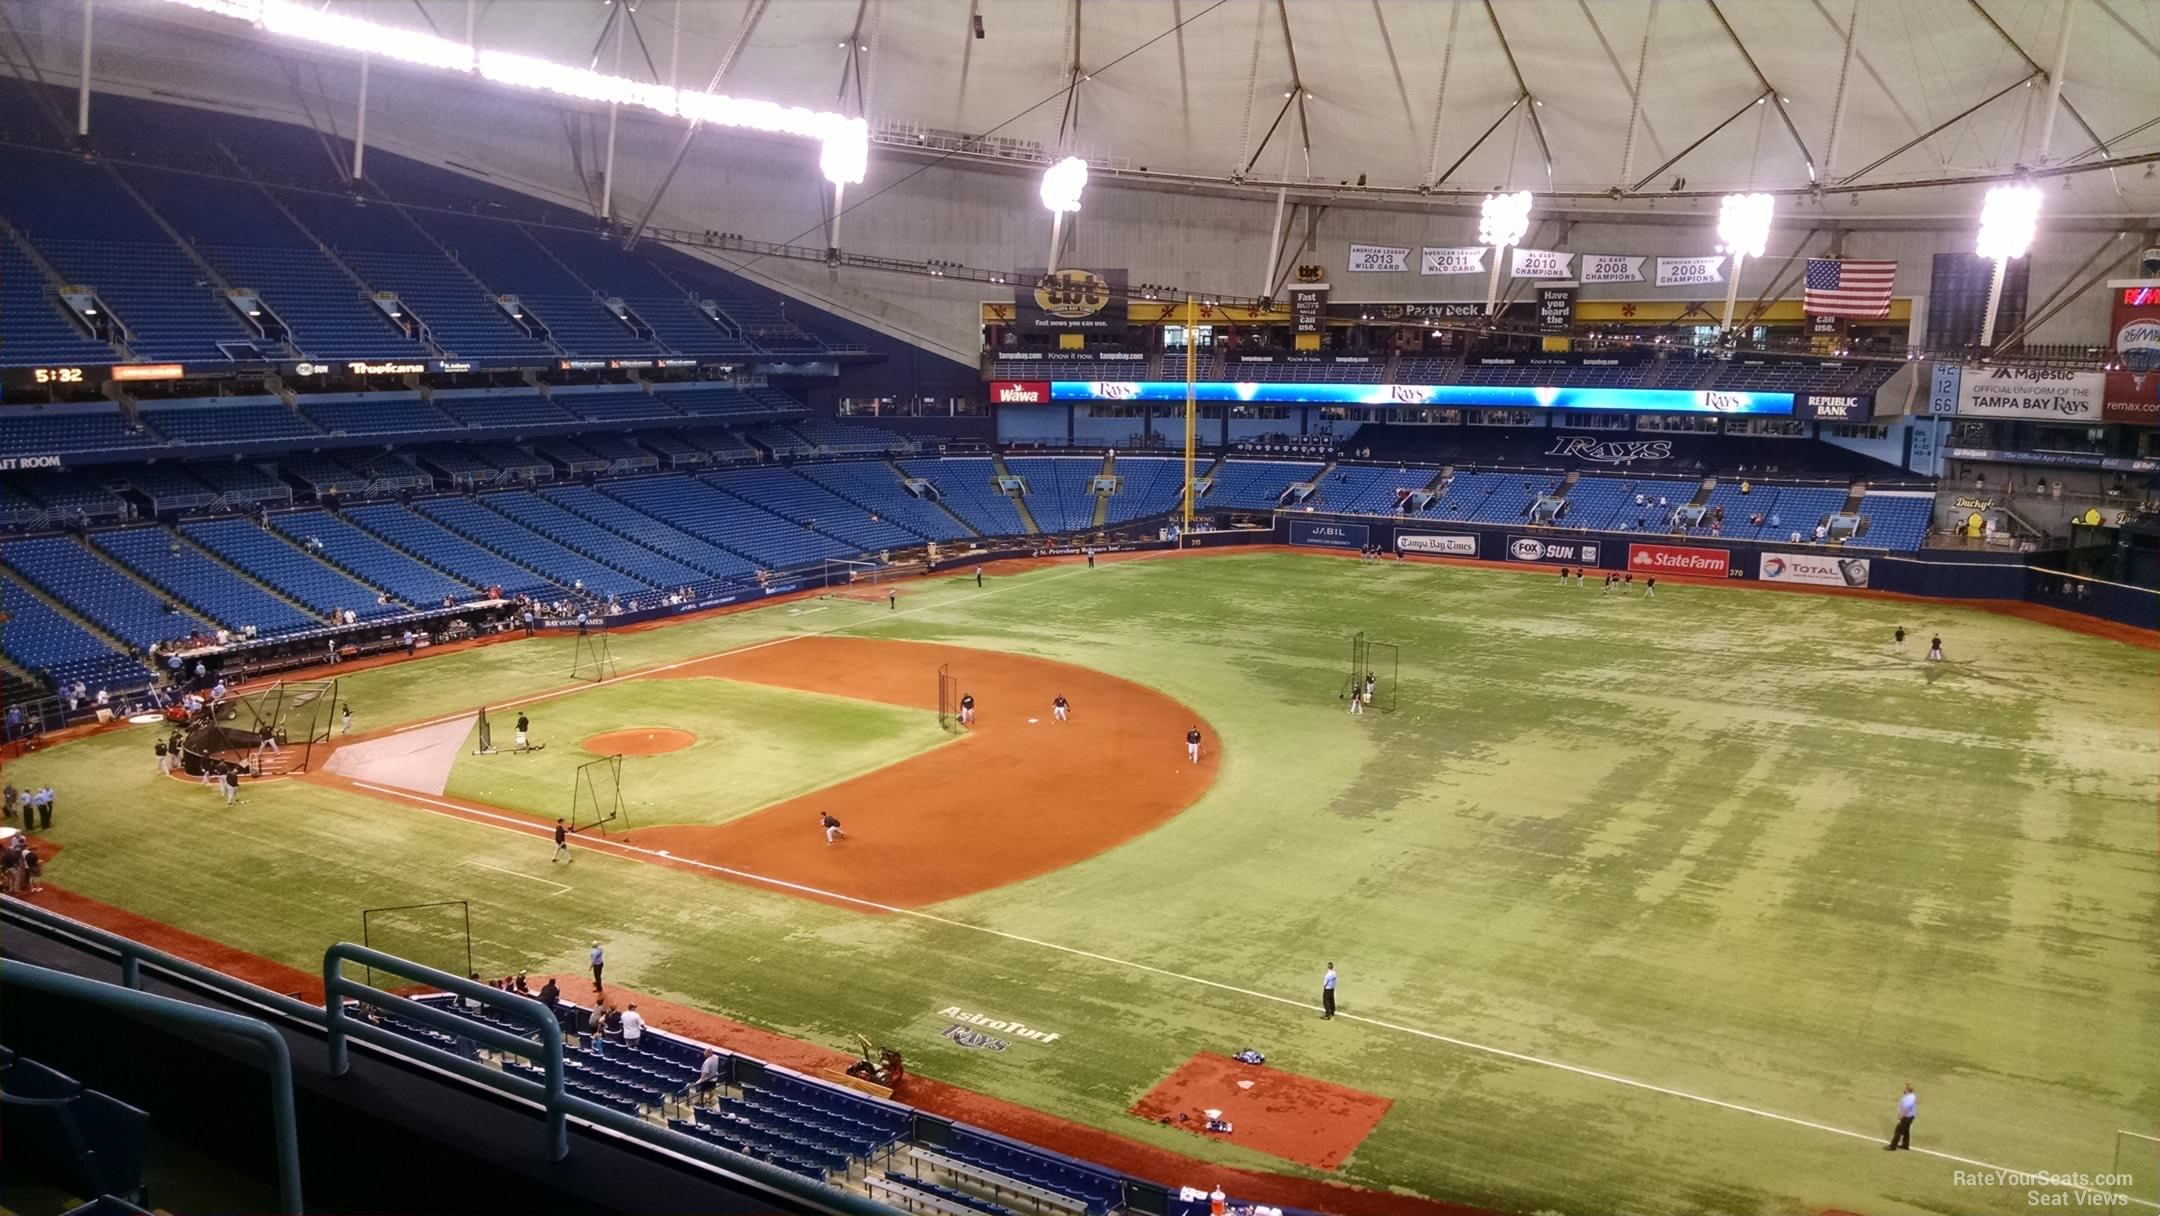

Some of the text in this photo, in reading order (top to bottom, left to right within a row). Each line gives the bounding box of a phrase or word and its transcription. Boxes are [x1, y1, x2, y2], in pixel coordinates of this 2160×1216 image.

[1364, 254, 1394, 264] 2013
[1438, 256, 1468, 266] 2011
[1525, 258, 1556, 268] 2010
[1595, 264, 1628, 273] 2008
[1672, 265, 1706, 276] 2008
[1660, 275, 1715, 283] CHAMPIONS
[1298, 293, 1316, 302] Fast
[1544, 292, 1568, 300] Have
[1446, 304, 1478, 316] Deck
[1547, 300, 1565, 310] you
[1541, 307, 1570, 316] heard
[1547, 316, 1564, 324] the
[999, 352, 1042, 360] tampabay.com
[1100, 352, 1144, 360] tampabay.com
[348, 362, 424, 374] Tropicana
[34, 368, 83, 383] 5:32
[2015, 368, 2074, 384] Majestic
[1938, 380, 1952, 394] 12
[1973, 385, 2090, 396] OFFICIAL UNIFORM OF THE
[1000, 389, 1039, 402] Wawa
[1808, 396, 1858, 408] REPUBLIC
[1934, 398, 1952, 412] 66
[1972, 396, 2019, 408] TAMPA
[2023, 398, 2050, 410] BAY
[1818, 406, 1848, 416] BANK
[20, 456, 60, 468] ROOM
[1312, 528, 1345, 536] JABIL
[1402, 538, 1472, 550] Tampa Bay Times
[1520, 543, 1538, 552] FOX
[1546, 544, 1574, 559] SUN
[1792, 563, 1838, 576] TOTAL
[937, 1006, 1063, 1044] AstroTurf
